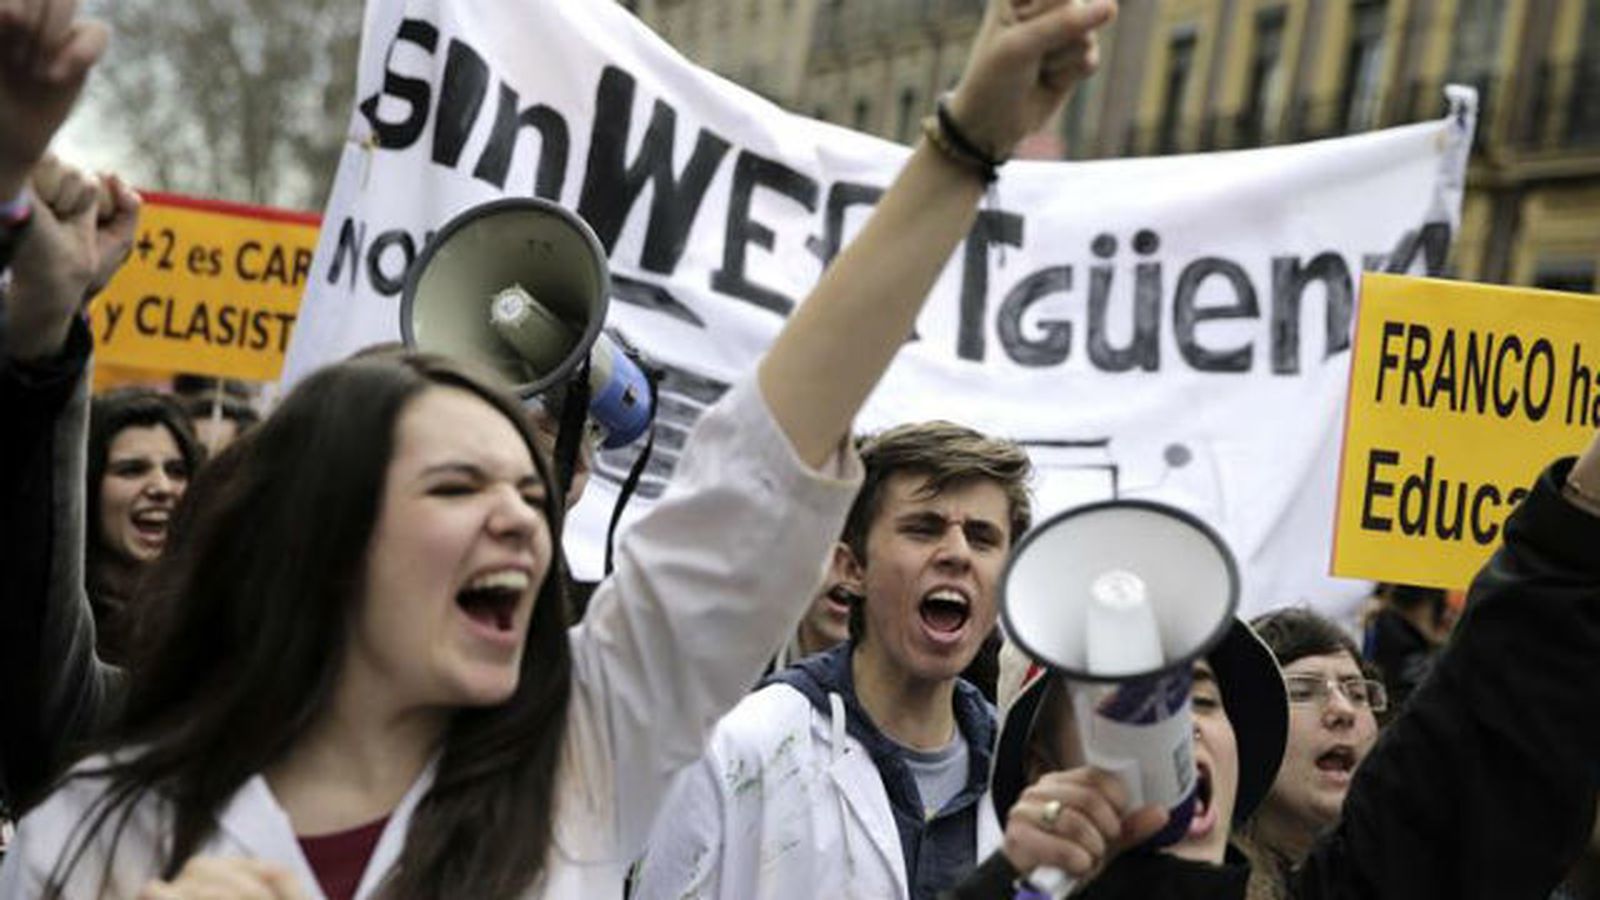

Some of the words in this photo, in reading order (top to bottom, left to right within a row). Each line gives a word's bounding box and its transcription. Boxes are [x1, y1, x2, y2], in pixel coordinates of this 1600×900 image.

[122, 228, 176, 271] +2
[186, 244, 223, 277] es
[102, 301, 125, 344] y
[134, 294, 297, 355] CLASIST
[1375, 320, 1556, 422] FRANCO
[1360, 448, 1531, 546] Educ
